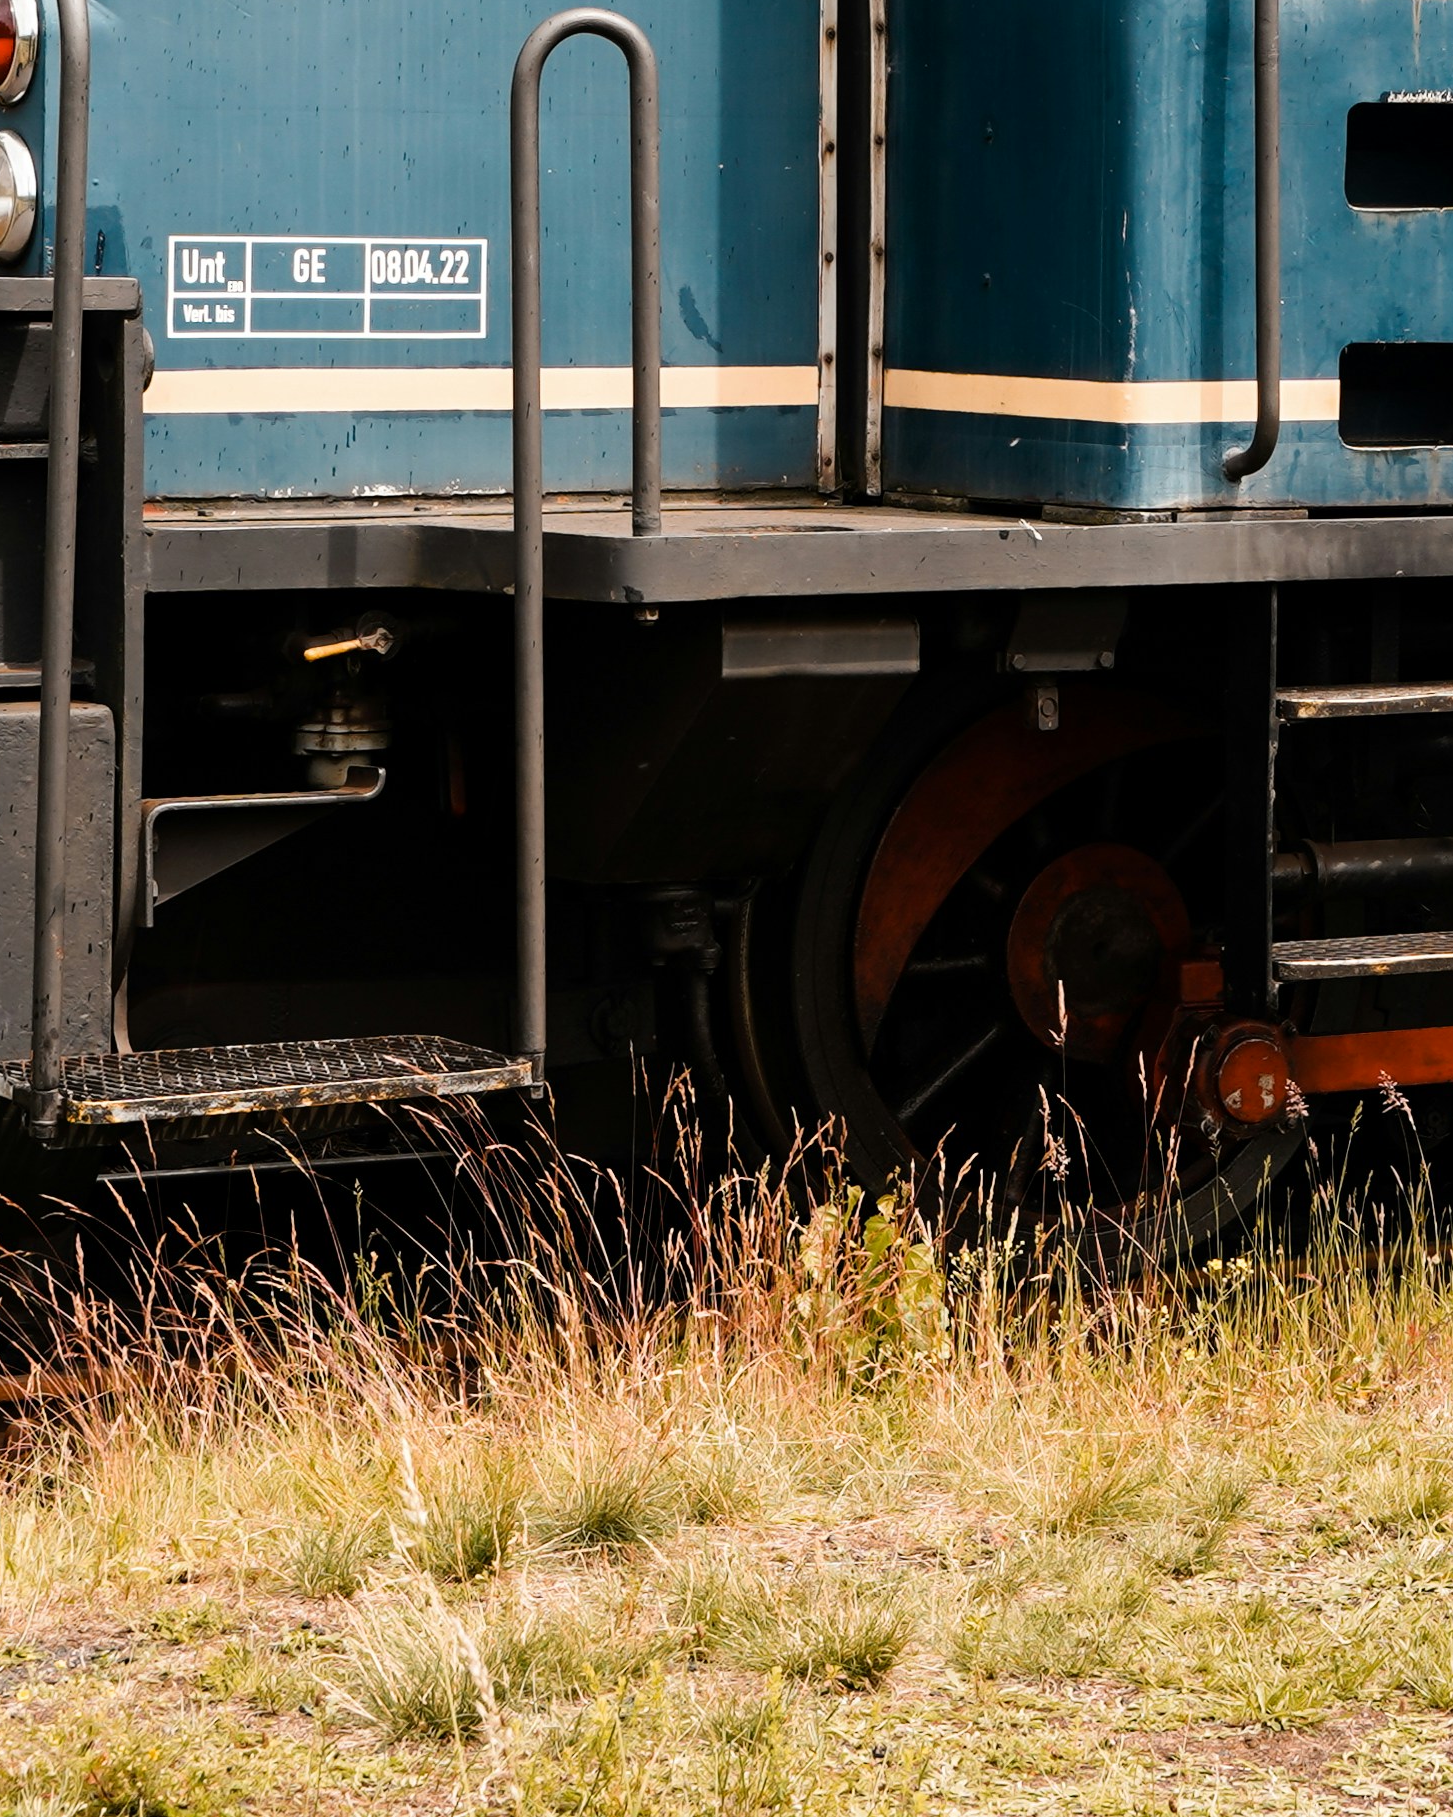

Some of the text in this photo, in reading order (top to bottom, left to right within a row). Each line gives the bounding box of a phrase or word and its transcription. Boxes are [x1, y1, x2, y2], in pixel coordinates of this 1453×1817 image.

[182, 248, 470, 285] Unt GE 08.04.22
[215, 304, 235, 323] bis
